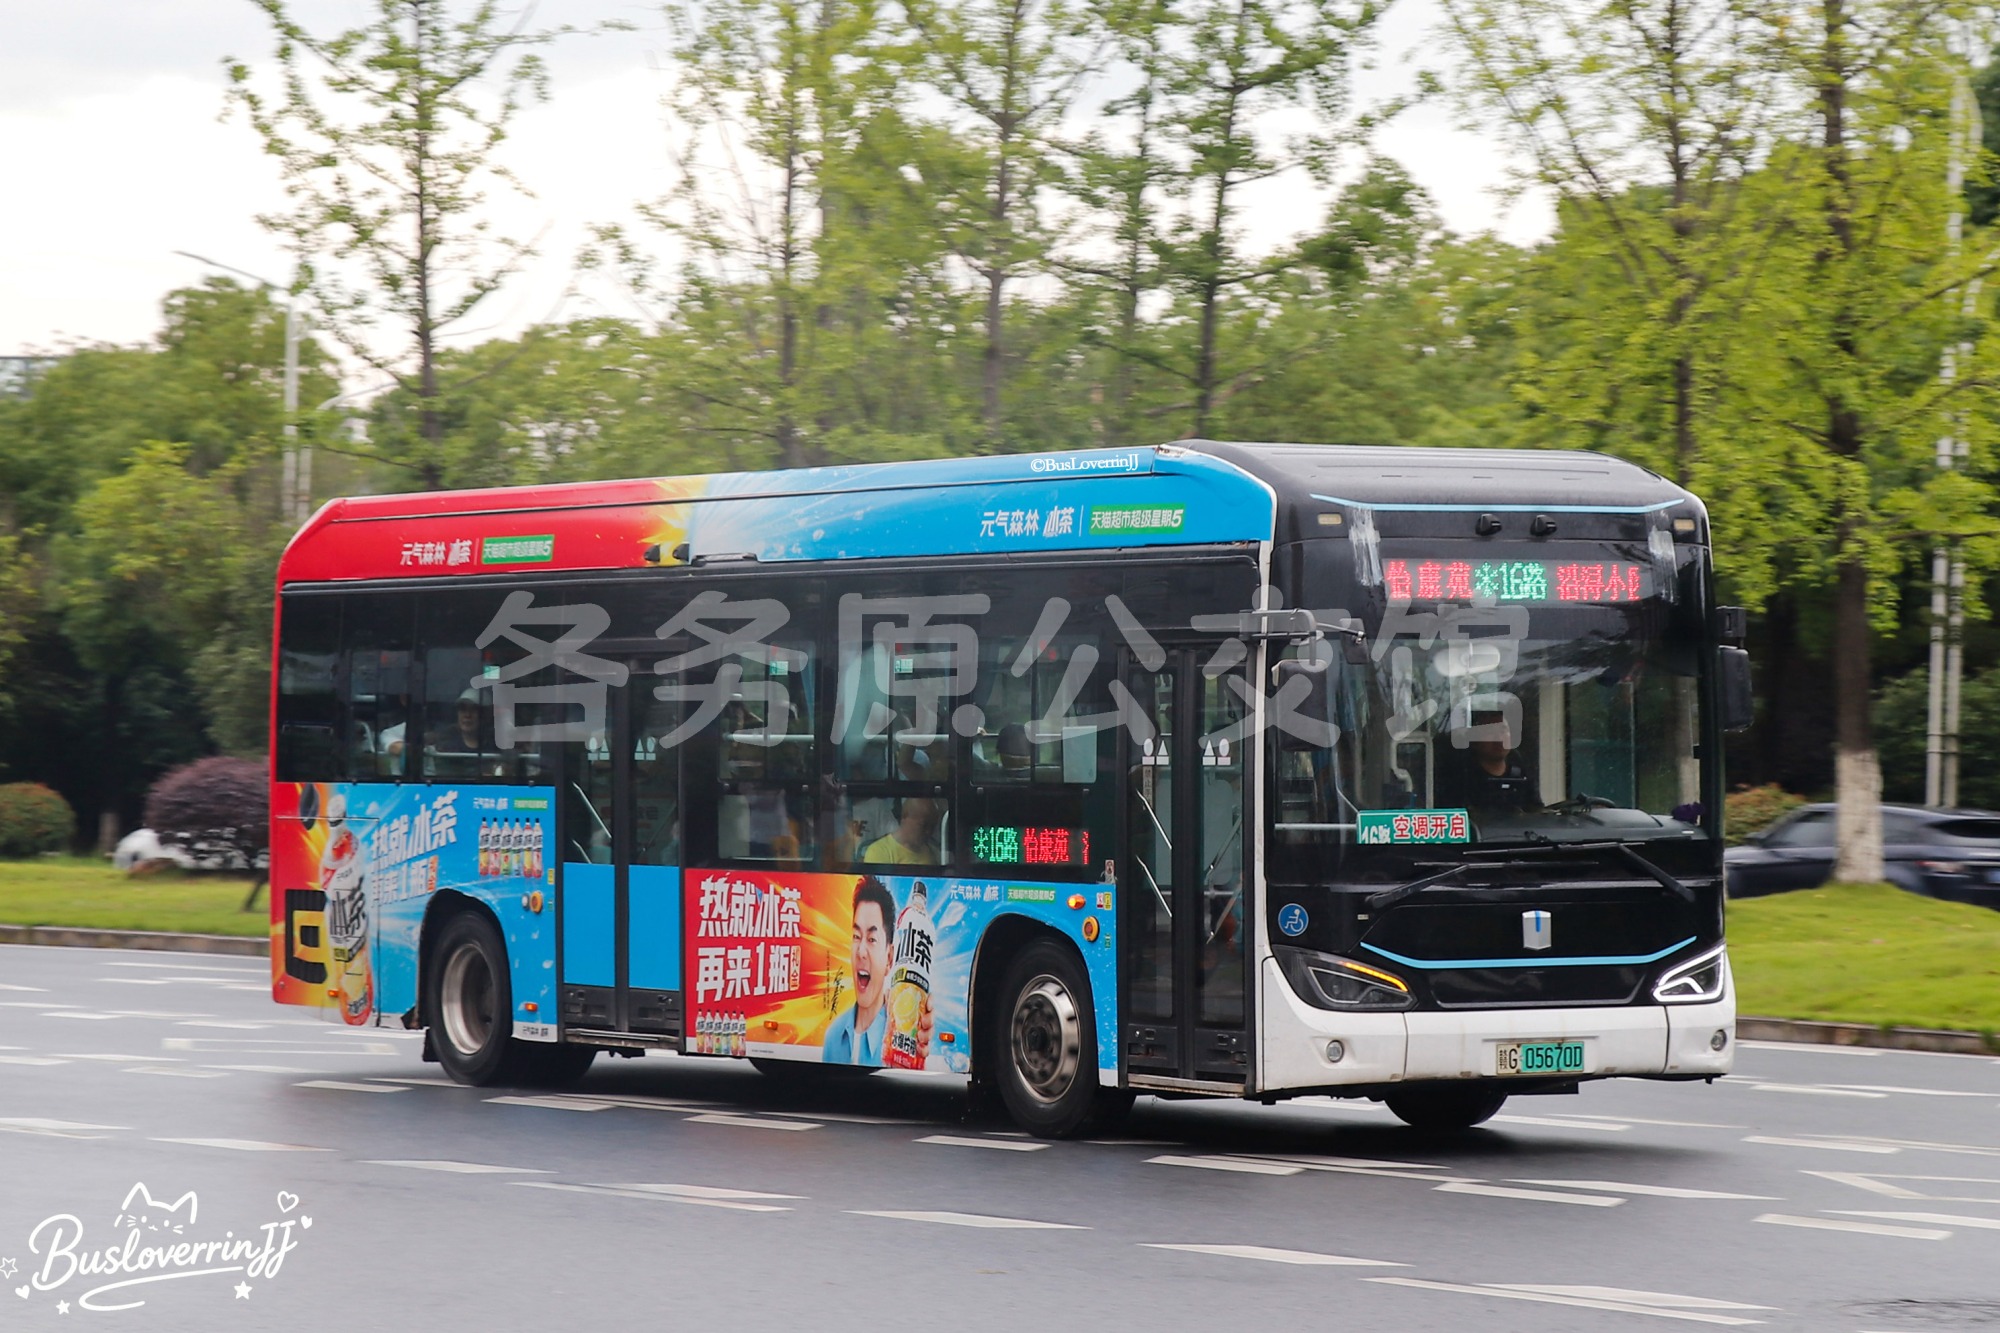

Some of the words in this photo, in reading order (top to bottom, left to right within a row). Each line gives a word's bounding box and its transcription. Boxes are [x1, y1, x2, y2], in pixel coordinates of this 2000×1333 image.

[979, 508, 1040, 537] 元气森林
[1042, 504, 1075, 538] 冰茶
[1090, 508, 1184, 530] 天猫超市超级星期5
[1386, 561, 1474, 600] 怡康苑
[1023, 826, 1070, 864] 怡康苑
[1392, 813, 1466, 839] 空调开启
[697, 871, 802, 938] 热就冰茶
[895, 921, 934, 975] 冰茶
[696, 941, 790, 1004] 再来1瓶
[1525, 1046, 1583, 1069] 05670D
